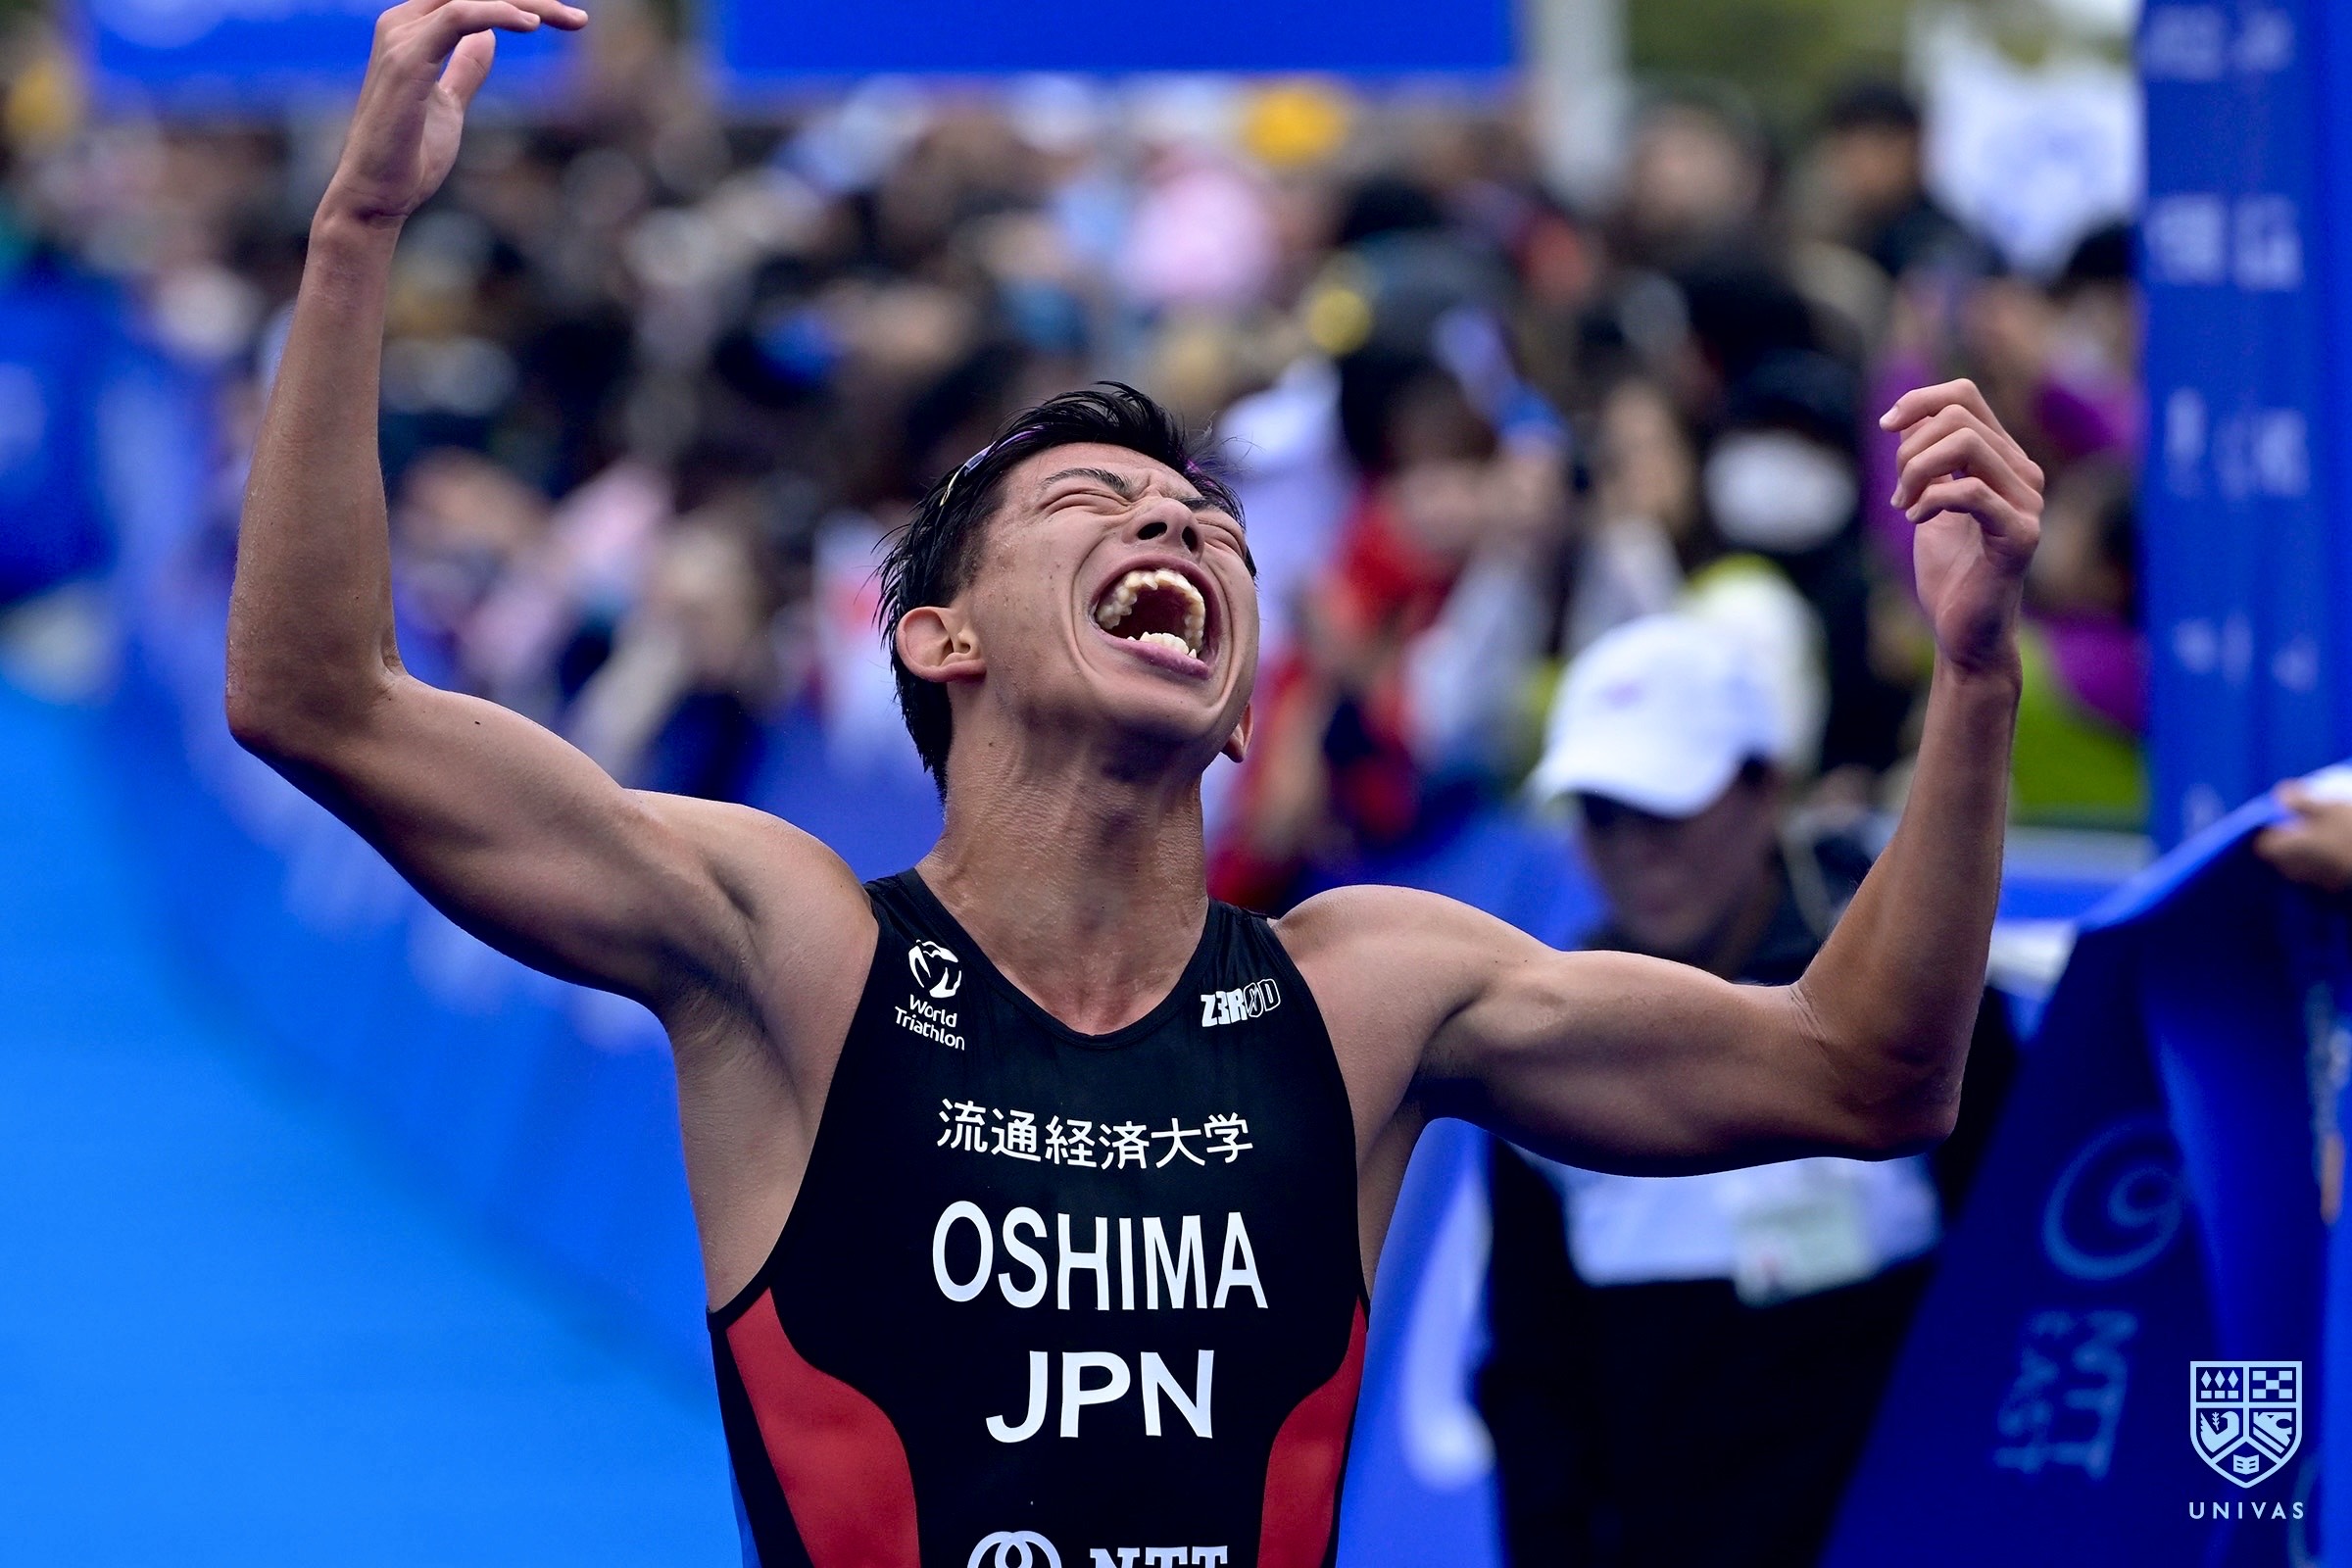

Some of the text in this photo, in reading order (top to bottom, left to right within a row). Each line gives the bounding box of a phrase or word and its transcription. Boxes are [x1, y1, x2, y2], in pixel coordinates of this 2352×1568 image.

[894, 1005, 965, 1051] Triathlon
[909, 994, 957, 1028] World
[936, 1098, 1254, 1170] 流通経済大学
[932, 1200, 1269, 1311] OSHIMA
[985, 1348, 1215, 1444] JPN
